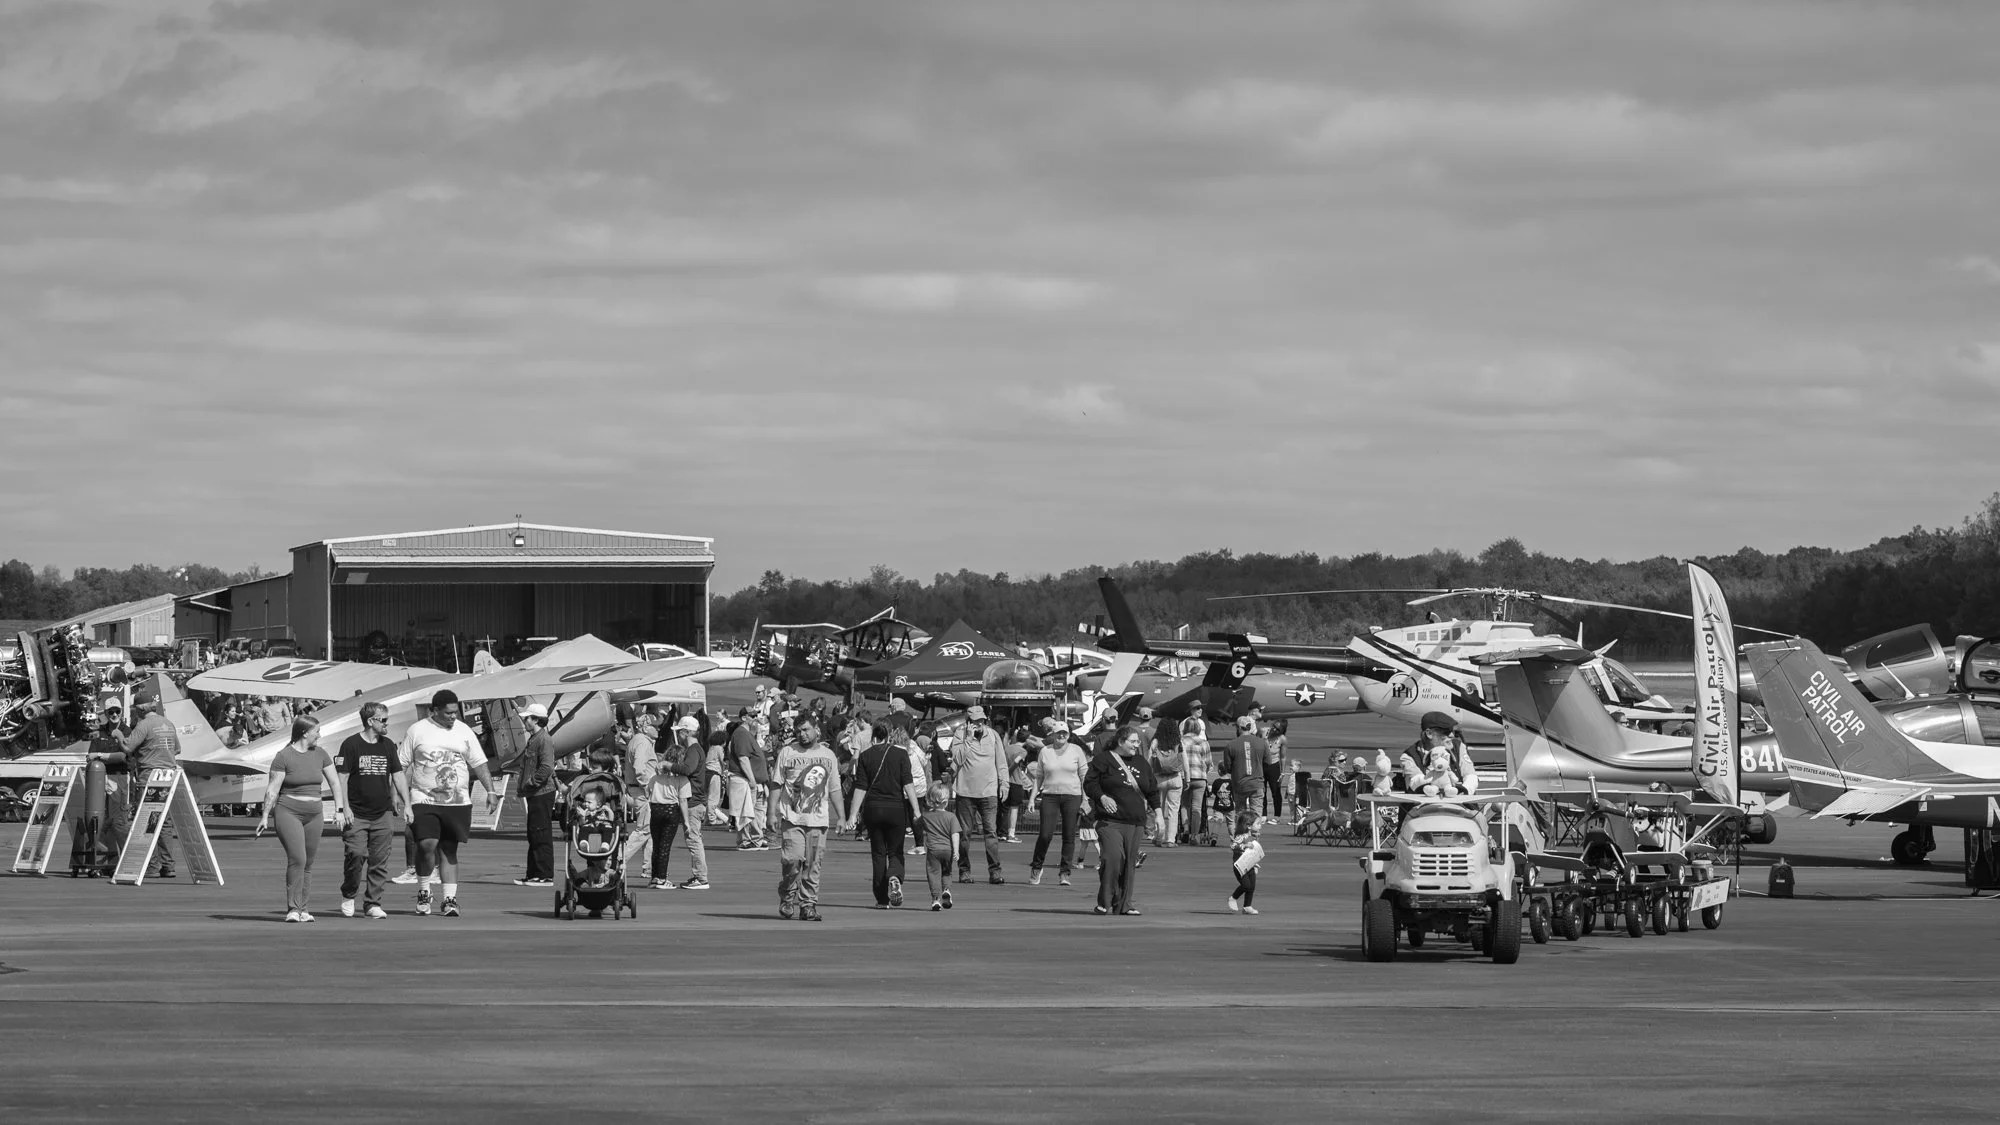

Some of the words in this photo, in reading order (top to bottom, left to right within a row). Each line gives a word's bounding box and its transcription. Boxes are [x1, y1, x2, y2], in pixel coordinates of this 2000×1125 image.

[1231, 661, 1246, 678] 6
[1702, 625, 1718, 689] Patrol
[1706, 696, 1721, 727] Air
[1801, 685, 1848, 744] PATROL
[1810, 670, 1842, 712] CIVIL
[1840, 707, 1866, 736] AIR
[1698, 731, 1720, 777] Civil
[1720, 755, 1728, 777] U.S.
[1803, 767, 1818, 775] STATES
